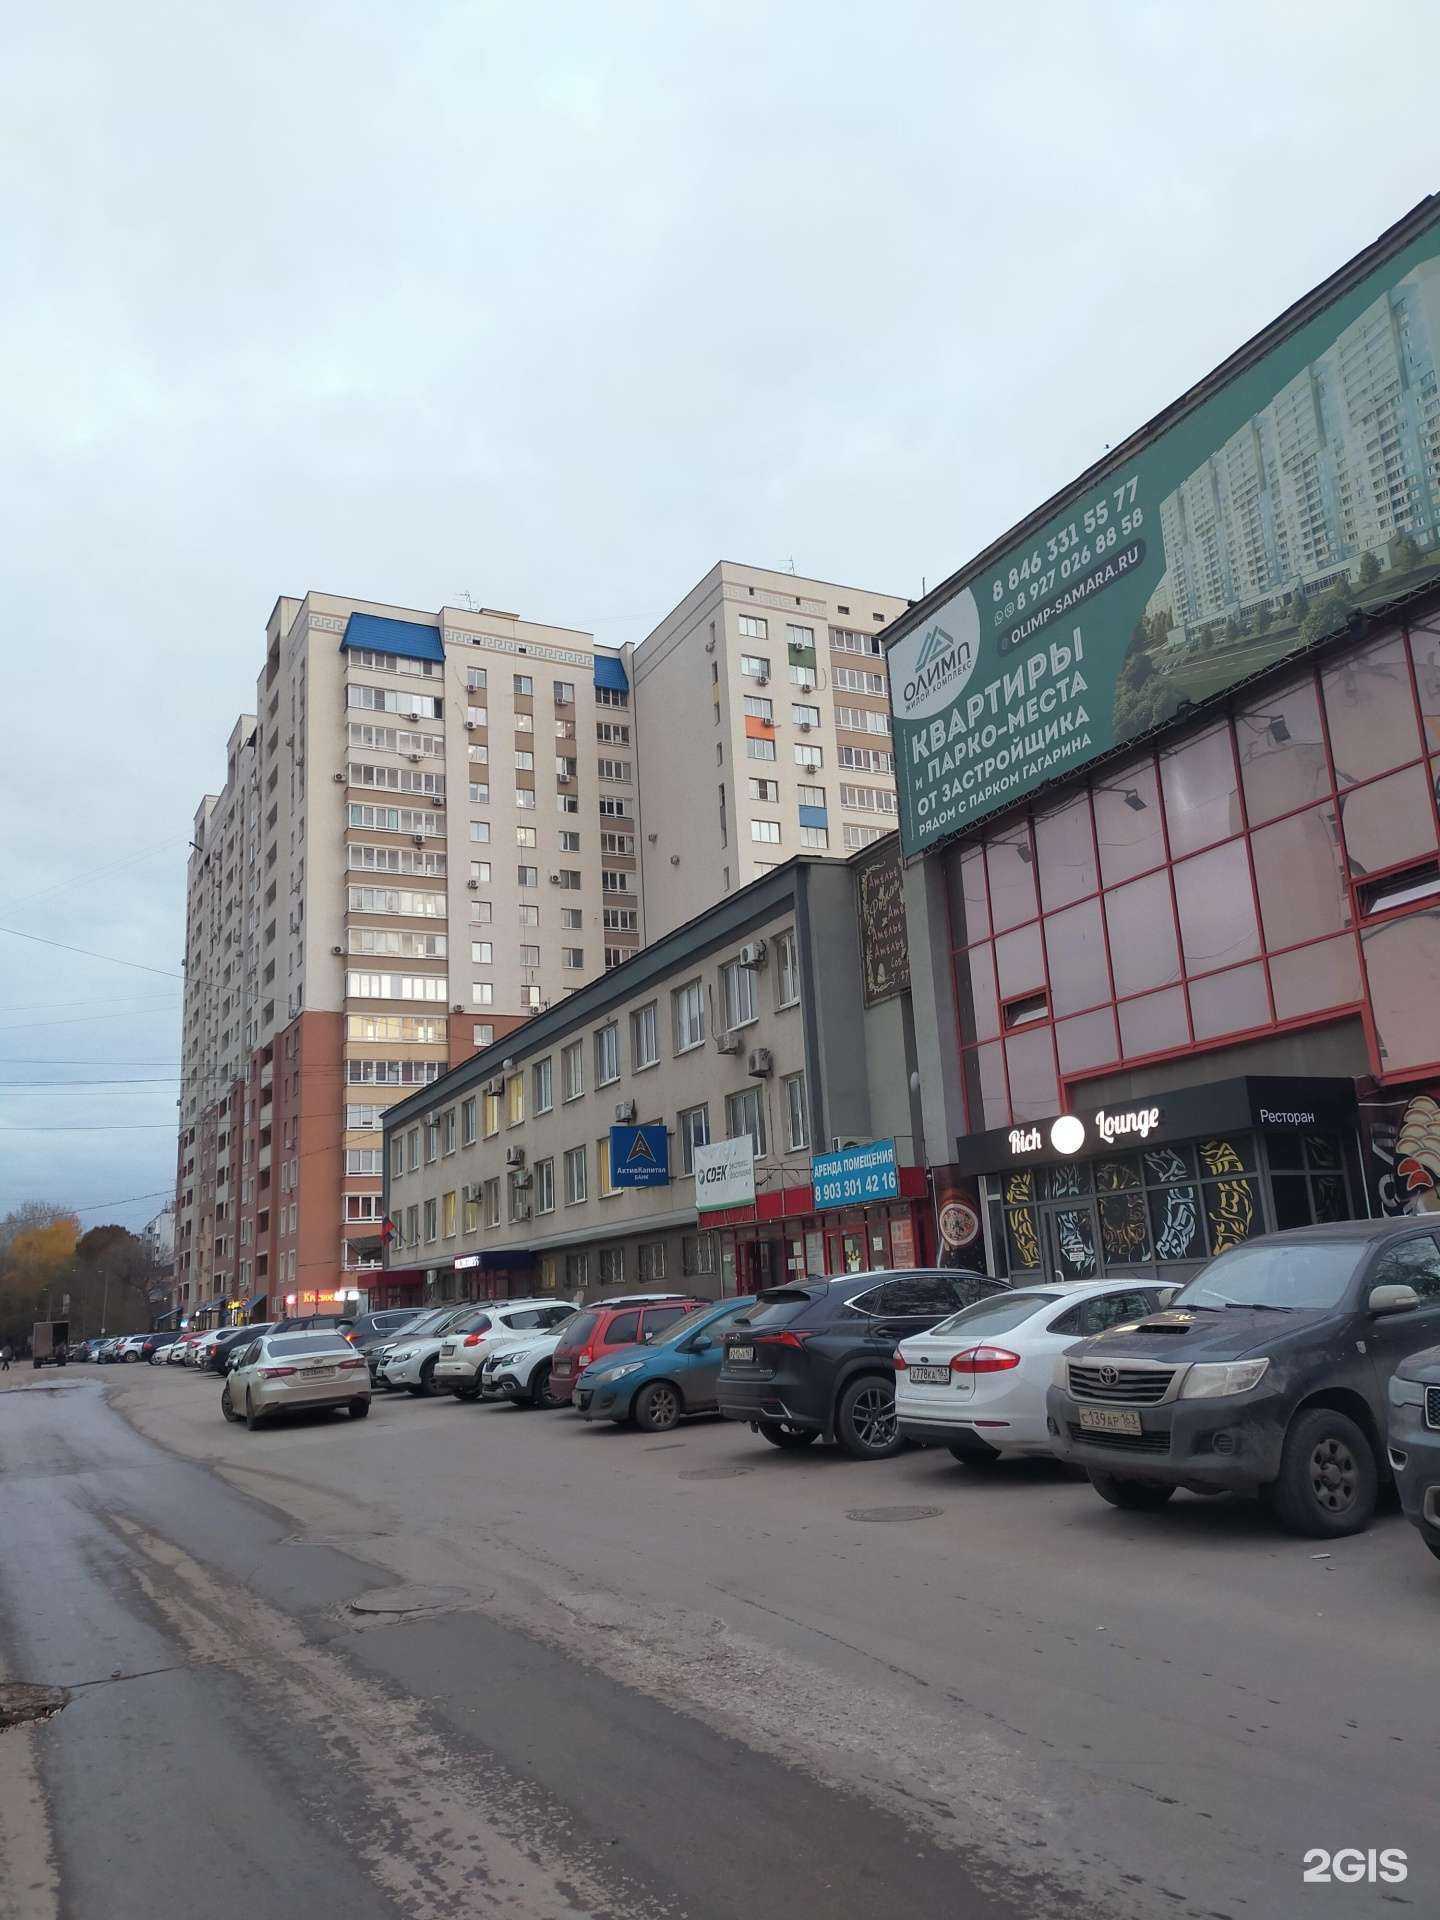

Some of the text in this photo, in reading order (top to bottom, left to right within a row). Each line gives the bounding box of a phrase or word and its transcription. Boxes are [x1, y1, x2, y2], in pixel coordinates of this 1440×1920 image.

[992, 475, 1138, 601] 8 846 331 55 77
[1017, 508, 1144, 610] 8 927 026 88 58
[1011, 546, 1139, 643] OLIMP-SAMARA.RU
[904, 642, 970, 701] ОЛИМП
[905, 660, 972, 712] ЖИЛОЙ КОМПЛЕКС
[912, 626, 1084, 764] КВАРТИРЫ
[917, 705, 1090, 816] ОТ ЗАСТРОЙЩИКА
[928, 671, 1088, 783] ПАРКО-МЕСТА
[919, 733, 1092, 836] РЯДОМ С ПАРКОМ ГАГАРИНА
[814, 1149, 893, 1178] АРЕНДА ПОМЕЩЕНИЯ
[1008, 1107, 1159, 1154] Rich Lounge
[1260, 1109, 1315, 1125] Ресторан
[815, 1172, 896, 1201] 8 903 301 42 16
